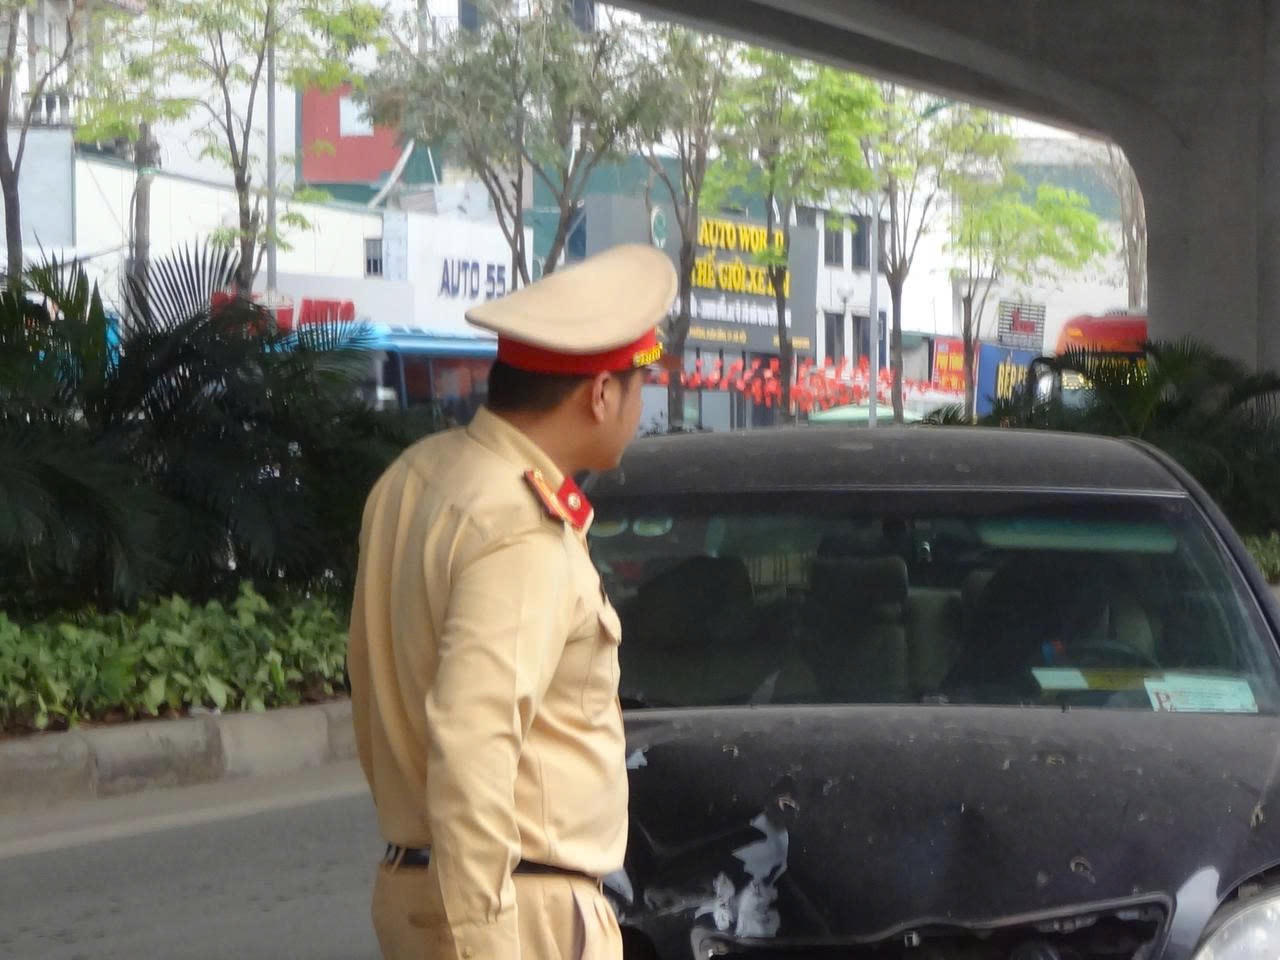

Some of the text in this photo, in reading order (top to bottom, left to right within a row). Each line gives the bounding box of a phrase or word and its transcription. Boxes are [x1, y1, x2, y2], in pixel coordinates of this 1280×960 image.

[699, 217, 785, 257] AUTO WORD
[440, 258, 506, 299] AUTO 55
